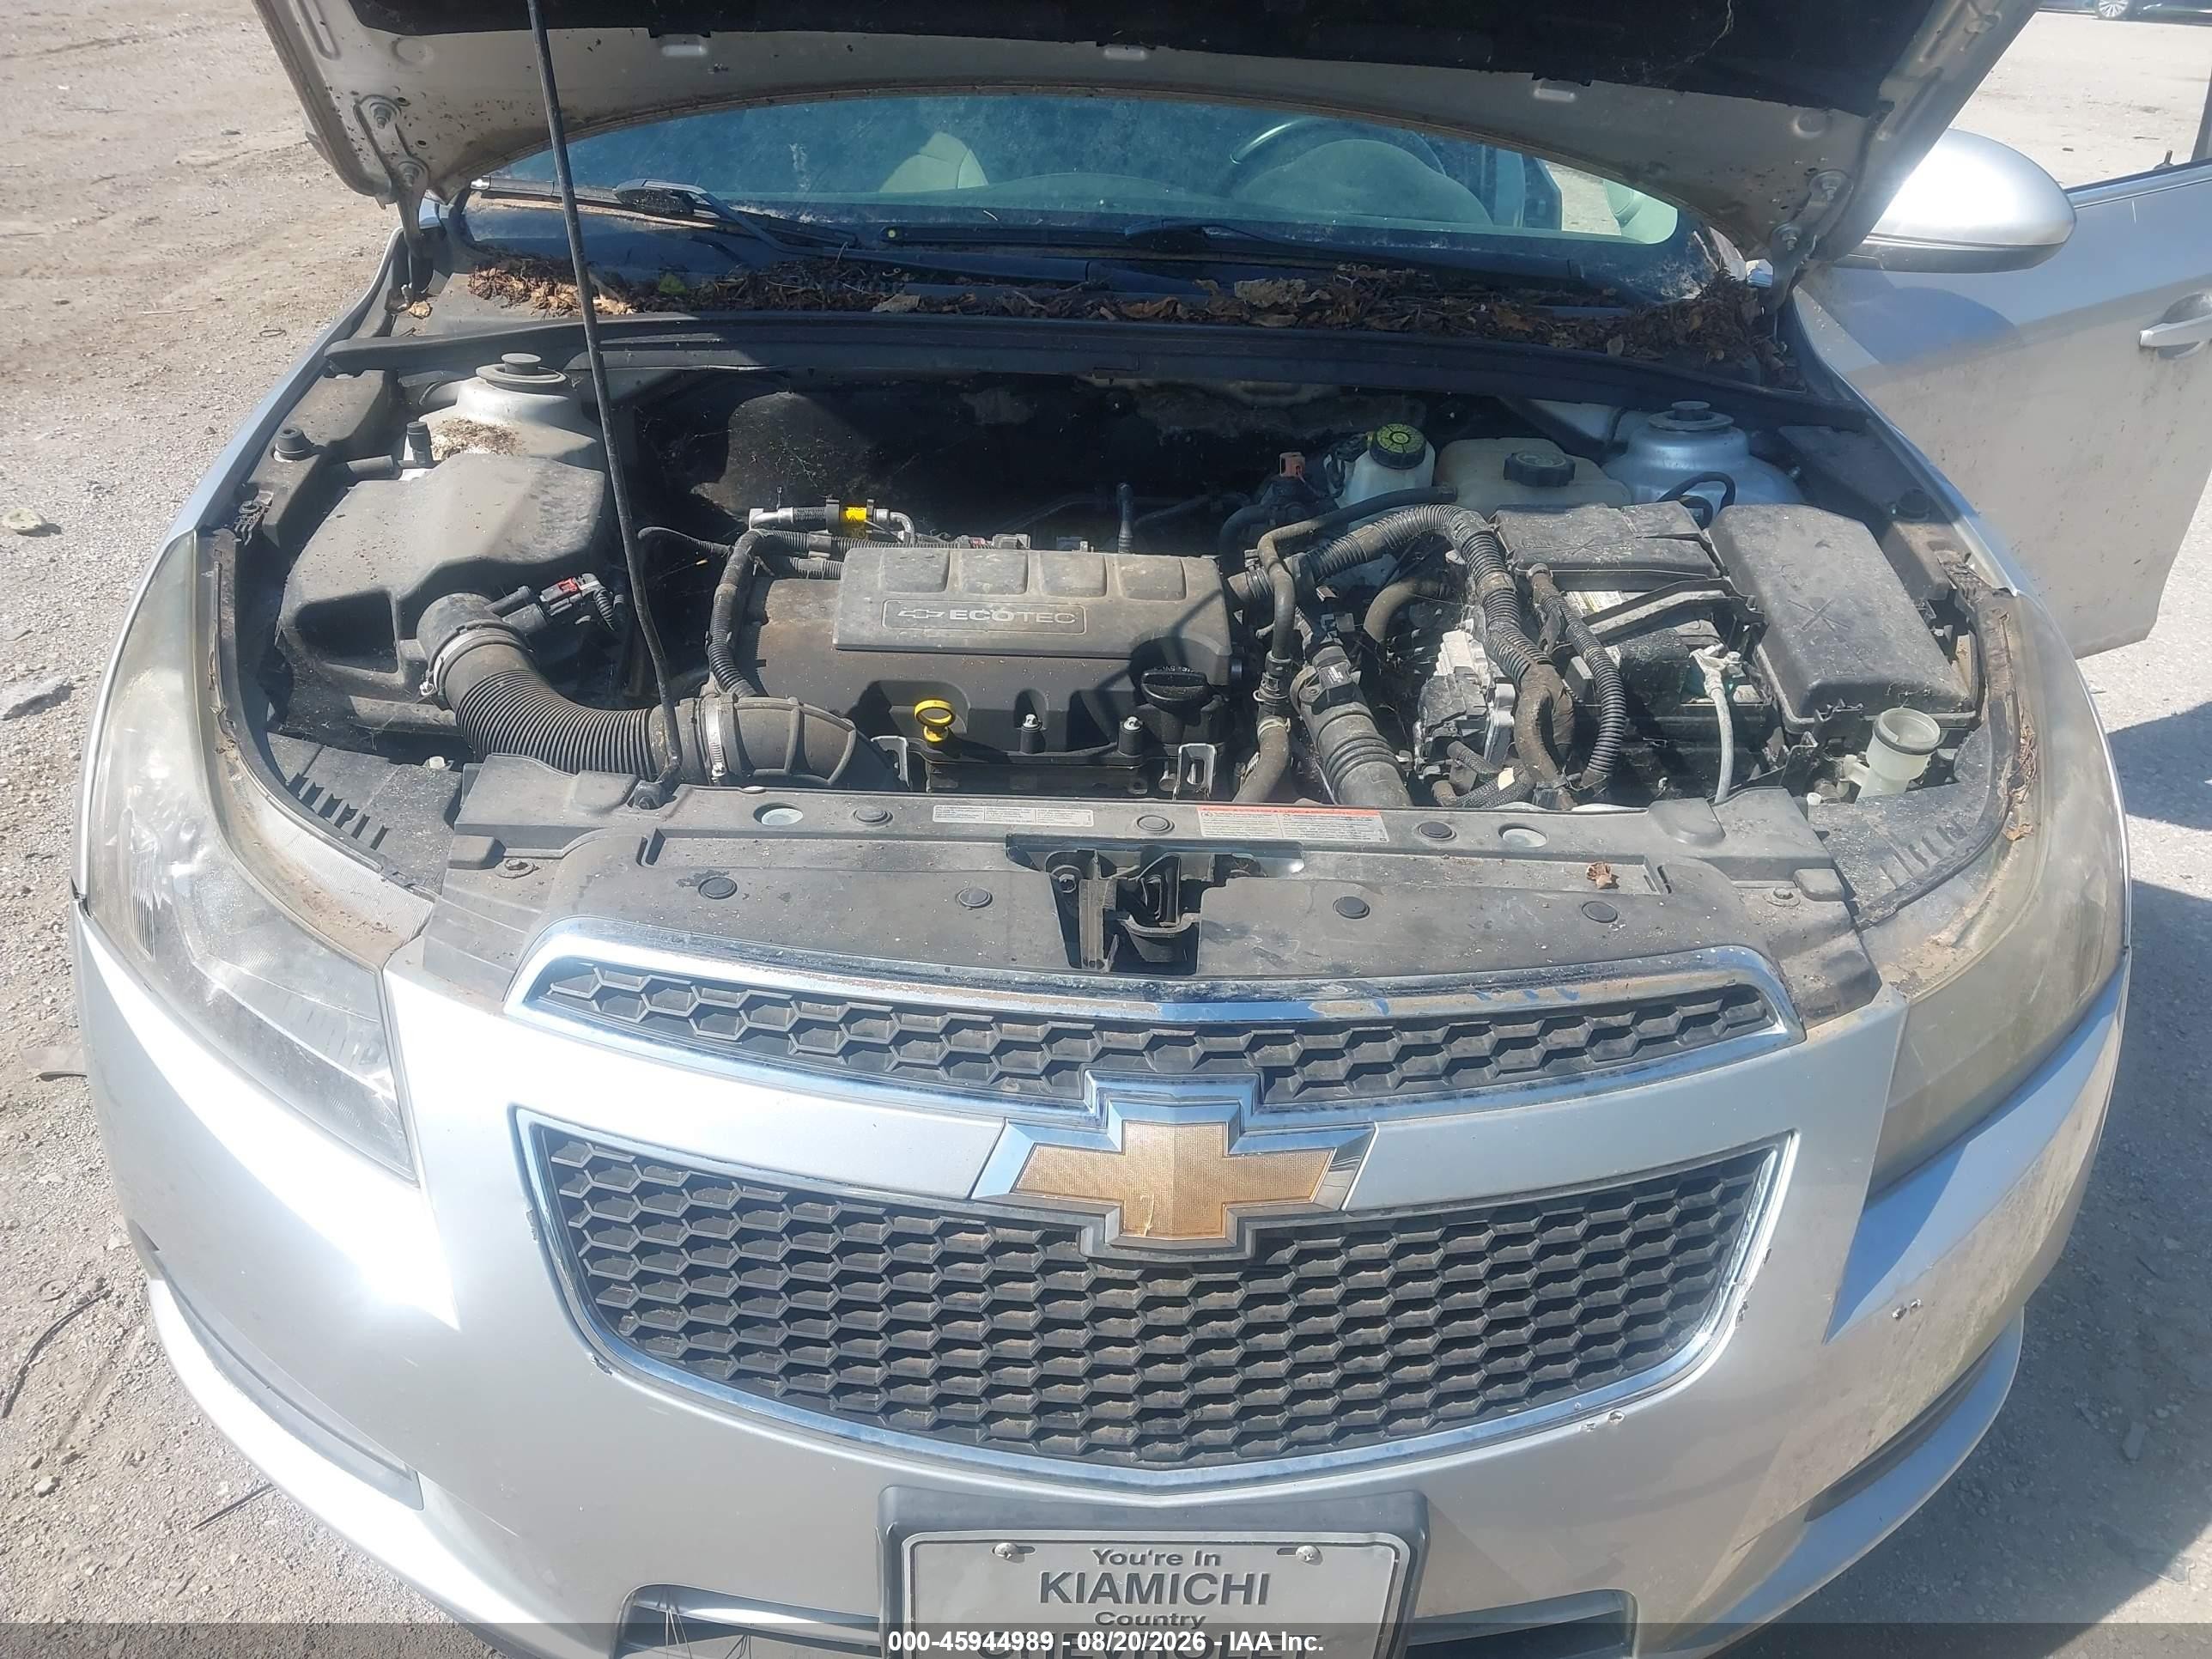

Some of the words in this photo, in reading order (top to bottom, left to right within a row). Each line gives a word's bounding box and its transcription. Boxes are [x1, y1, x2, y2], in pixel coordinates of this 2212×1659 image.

[950, 608, 1076, 624] ECOTEC
[1092, 1548, 1183, 1566] You're
[1194, 1550, 1221, 1566] In
[1040, 1571, 1270, 1605] KIAMICHI
[1094, 1611, 1206, 1631] Country
